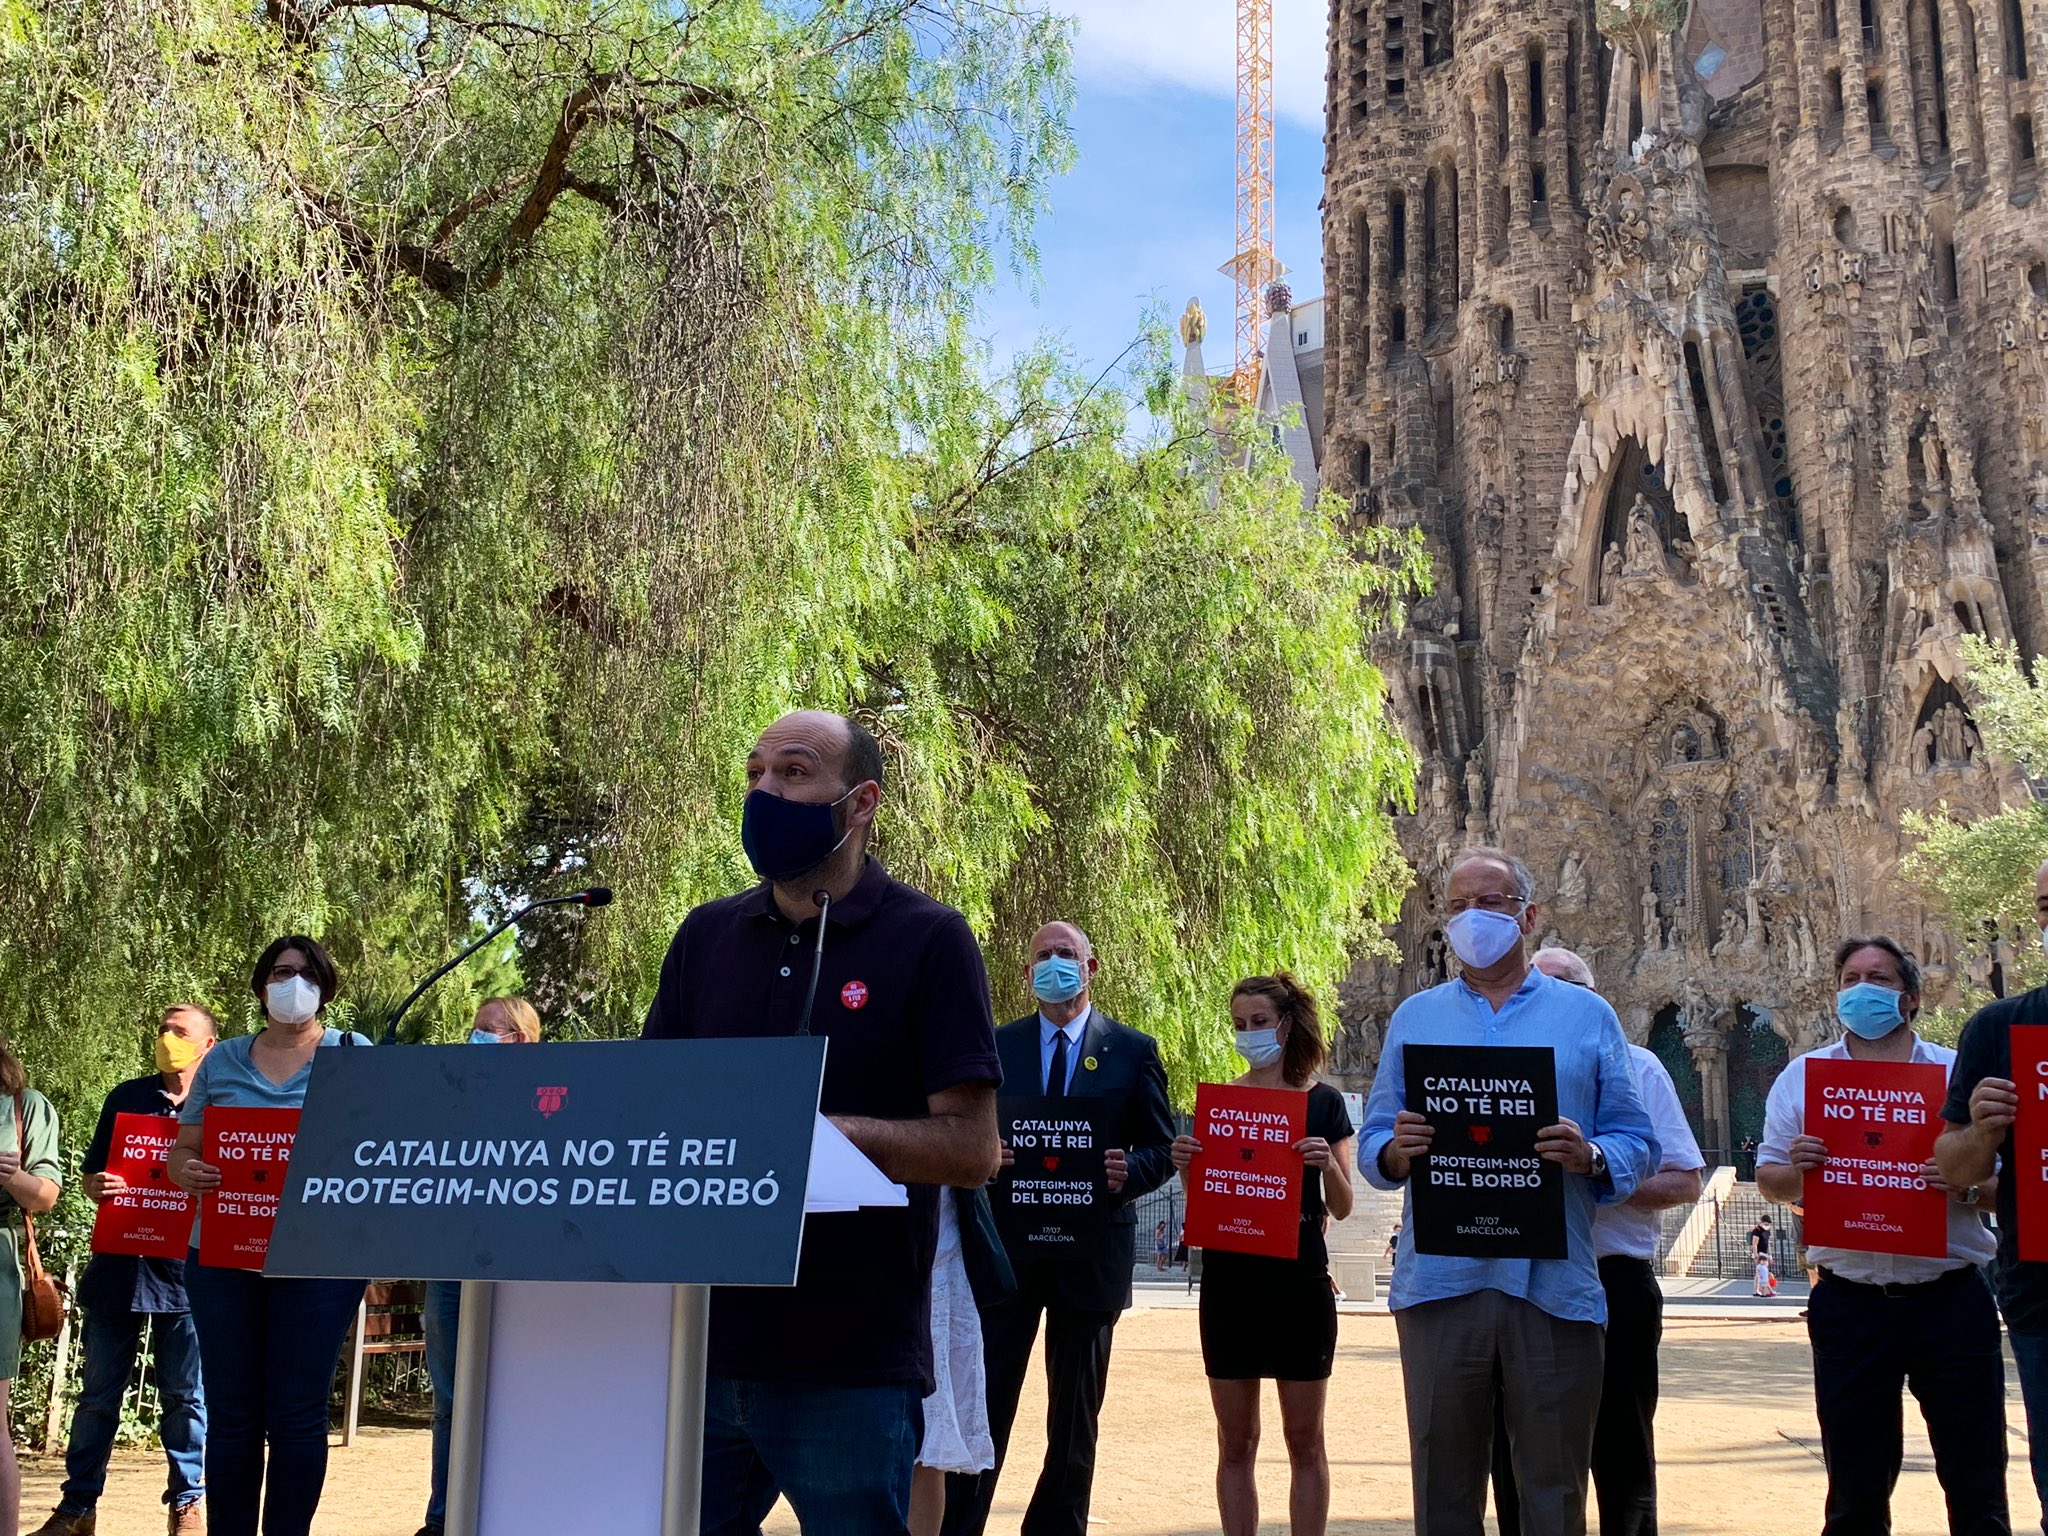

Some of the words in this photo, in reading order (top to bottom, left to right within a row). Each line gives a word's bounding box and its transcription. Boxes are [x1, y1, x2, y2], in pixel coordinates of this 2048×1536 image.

[1424, 1077, 1533, 1093] CATALUNYA
[1823, 1087, 1925, 1104] CATALUNYA
[1426, 1096, 1458, 1113] NO
[1465, 1094, 1492, 1114] TÉ
[1500, 1099, 1534, 1115] REI
[1210, 1108, 1289, 1126] CATALUNYA
[1824, 1104, 1854, 1119] NO
[1861, 1104, 1886, 1121] TÉ
[1893, 1108, 1925, 1124] REI
[1012, 1120, 1092, 1131] CATALUNYA
[219, 1132, 296, 1144] CATALUNY
[1013, 1135, 1036, 1147] NO
[1042, 1132, 1061, 1147] TÉ
[1067, 1136, 1092, 1148] REI
[1209, 1123, 1233, 1136] NO
[1239, 1124, 1258, 1140] TÉ
[1264, 1128, 1289, 1143] REI
[126, 1135, 176, 1147] CATALU
[123, 1147, 146, 1159] NO
[150, 1148, 168, 1162] TÉ
[219, 1146, 245, 1160] NO
[251, 1145, 272, 1160] TÉ
[353, 1139, 550, 1167] CATALUNYA
[562, 1140, 614, 1166] NO
[628, 1132, 669, 1166] TÉ
[680, 1139, 736, 1165] REI
[1430, 1156, 1540, 1168] PROTEGIM-NOS
[1206, 1168, 1287, 1185] PROTEGIM-NOS
[1431, 1171, 1466, 1186] DEL
[1472, 1170, 1541, 1187] BORBÓ
[1824, 1170, 1857, 1184] DEL
[302, 1178, 559, 1205] PROTEGIM-NOS
[570, 1178, 636, 1205] DEL
[649, 1170, 779, 1205] BORBÓ
[1012, 1180, 1092, 1190] PROTEGIM-NOS
[1204, 1180, 1231, 1194] DEL
[1236, 1184, 1286, 1200] BORBÓ
[122, 1186, 189, 1200] ROTEGIM-NOS
[1012, 1193, 1038, 1203] DEL
[1043, 1191, 1092, 1204] BORBÓ
[114, 1196, 138, 1207] DEL
[142, 1199, 187, 1211] BORBÓ
[218, 1203, 245, 1215] DEL
[1234, 1218, 1252, 1226] 17/07
[1475, 1217, 1499, 1225] 17/07
[1862, 1213, 1885, 1221] 17/07
[1218, 1224, 1265, 1236] BARCELONA
[1457, 1226, 1520, 1235] BARCELONA
[1844, 1220, 1903, 1232] BARCELONA
[123, 1233, 164, 1241] BARCELONA
[1028, 1234, 1074, 1242] BARCELONA
